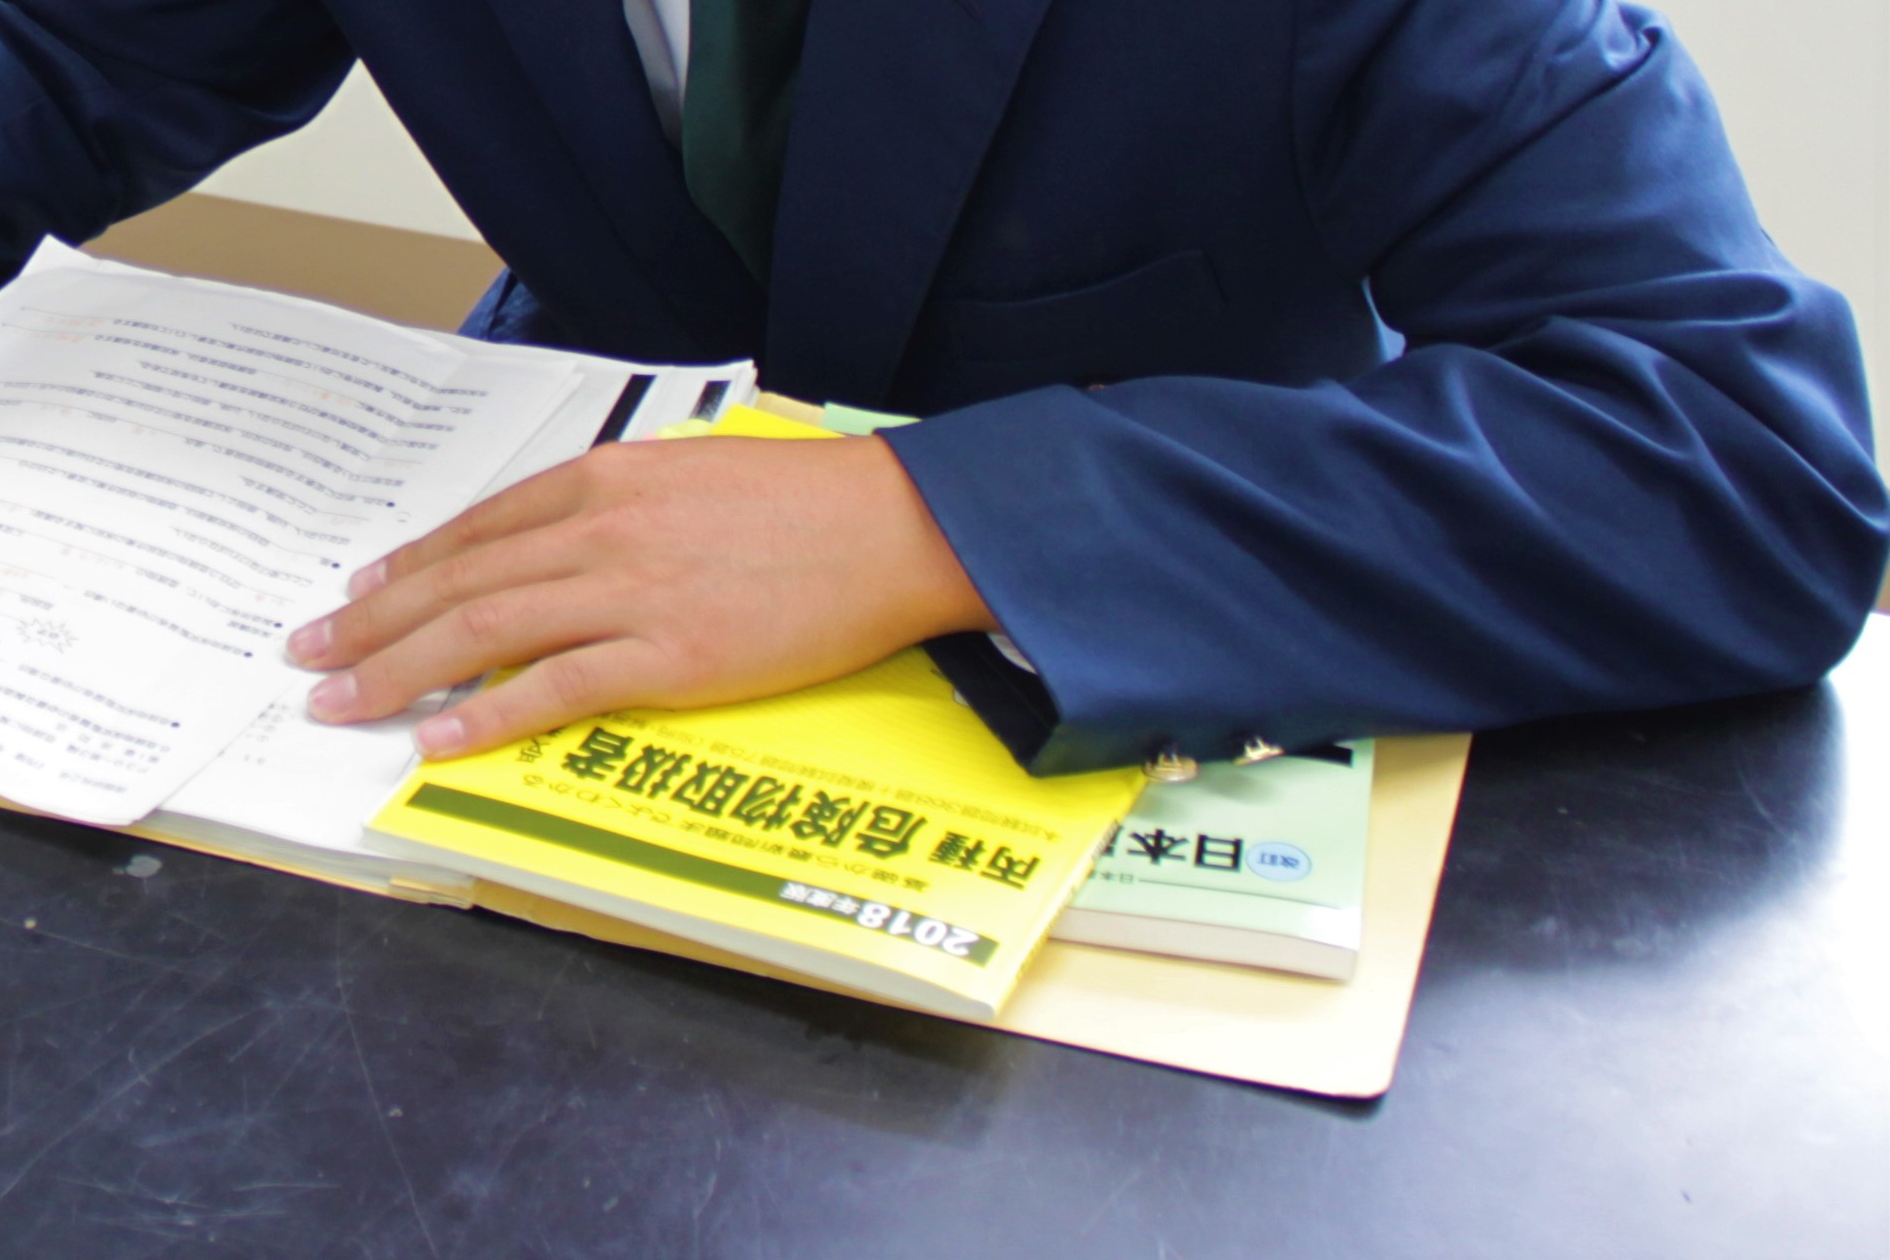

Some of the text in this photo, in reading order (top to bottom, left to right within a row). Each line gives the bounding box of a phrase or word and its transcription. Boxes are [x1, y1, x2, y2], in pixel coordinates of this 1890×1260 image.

[560, 726, 1042, 891] 丙種 危険物取扱者
[1087, 868, 1135, 885] 日本
[1102, 822, 1244, 873] 日本
[778, 880, 981, 958] 2018年度版
